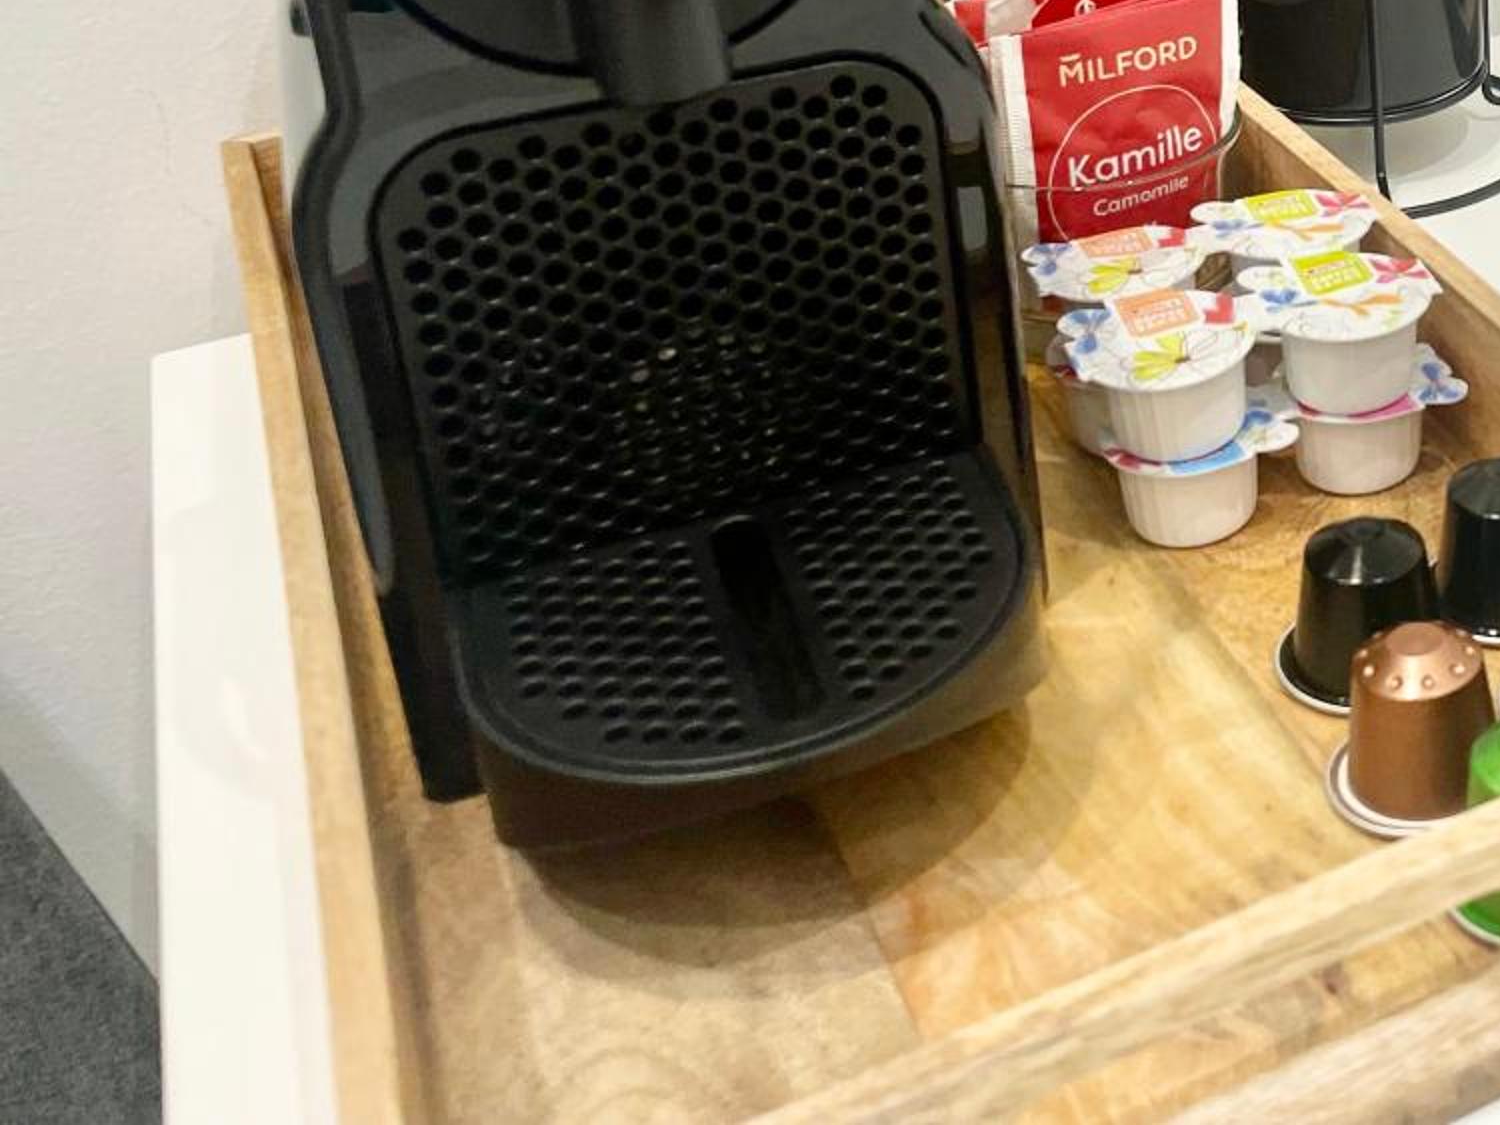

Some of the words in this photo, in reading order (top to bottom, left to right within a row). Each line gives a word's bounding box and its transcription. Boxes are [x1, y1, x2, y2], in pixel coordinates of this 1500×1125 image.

[1058, 35, 1198, 88] MILFORD
[1067, 124, 1203, 192] Kamille
[1093, 176, 1190, 216] Camomile
